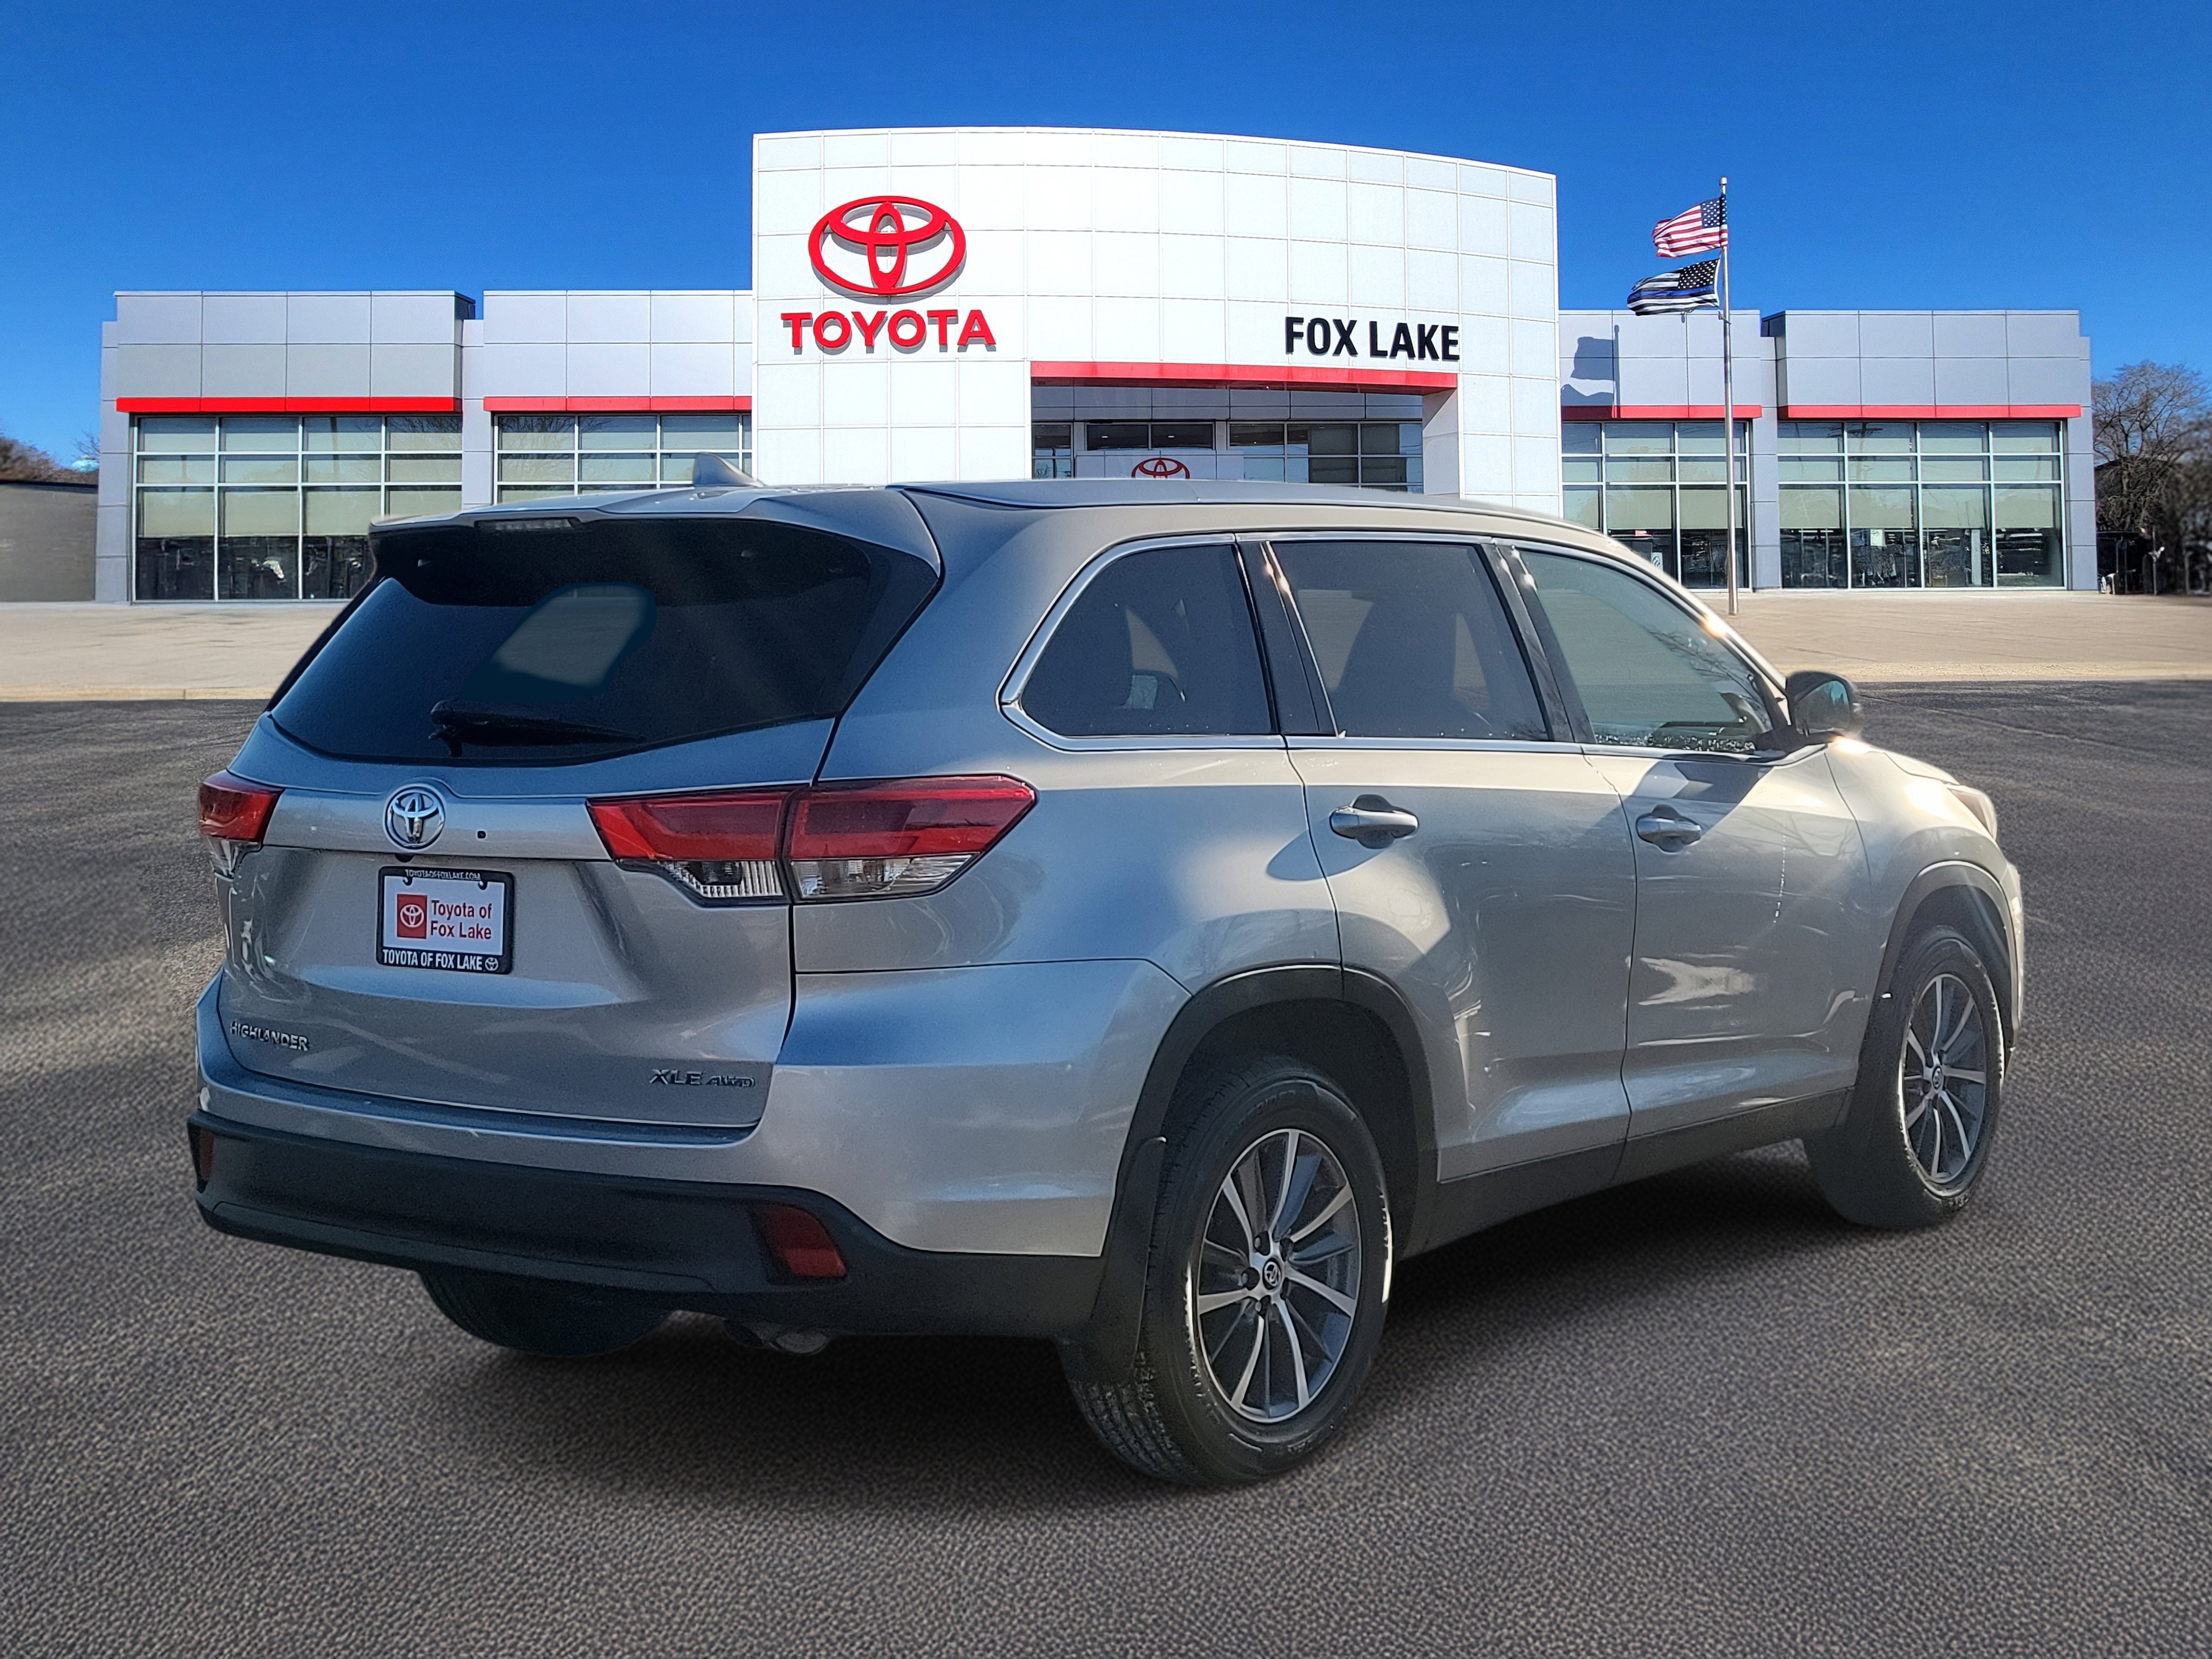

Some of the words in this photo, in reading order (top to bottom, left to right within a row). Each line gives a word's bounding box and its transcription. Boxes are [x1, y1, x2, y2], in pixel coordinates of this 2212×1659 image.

[781, 309, 997, 349] TOYOTA
[1285, 317, 1358, 357] FOX
[1369, 321, 1460, 361] LAKE
[431, 900, 474, 920] Toyota
[479, 903, 492, 919] of
[430, 920, 455, 938] Fox
[459, 922, 492, 939] Lake
[383, 949, 418, 966] TOYOTA
[420, 952, 433, 967] OF
[435, 953, 455, 969] FOX
[457, 955, 483, 970] LAKE
[230, 1021, 309, 1051] HIGHLANDER
[649, 1069, 703, 1085] XLE
